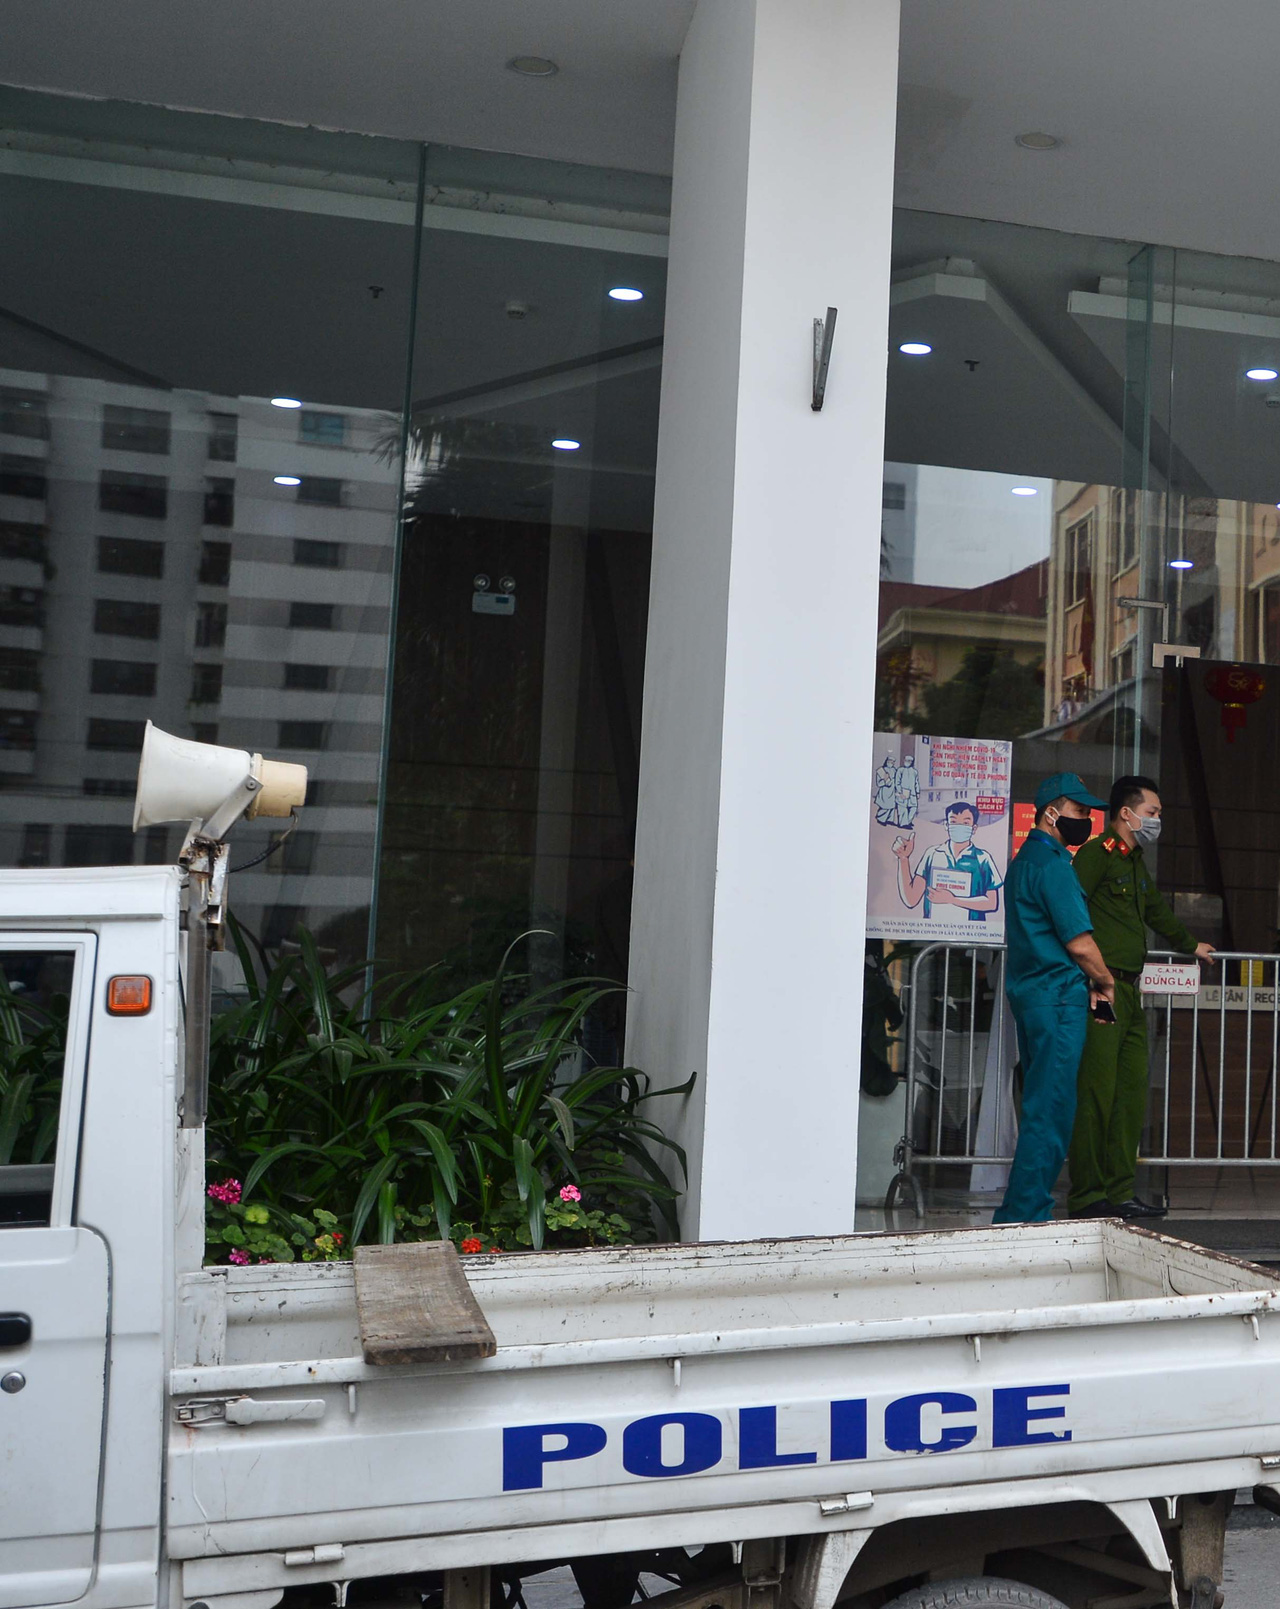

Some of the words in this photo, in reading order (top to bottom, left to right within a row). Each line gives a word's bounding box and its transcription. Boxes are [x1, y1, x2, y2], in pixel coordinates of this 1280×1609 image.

[1145, 974, 1175, 985] DỪNG
[1178, 978, 1195, 988] LẠI
[502, 1383, 1073, 1492] POLICE
